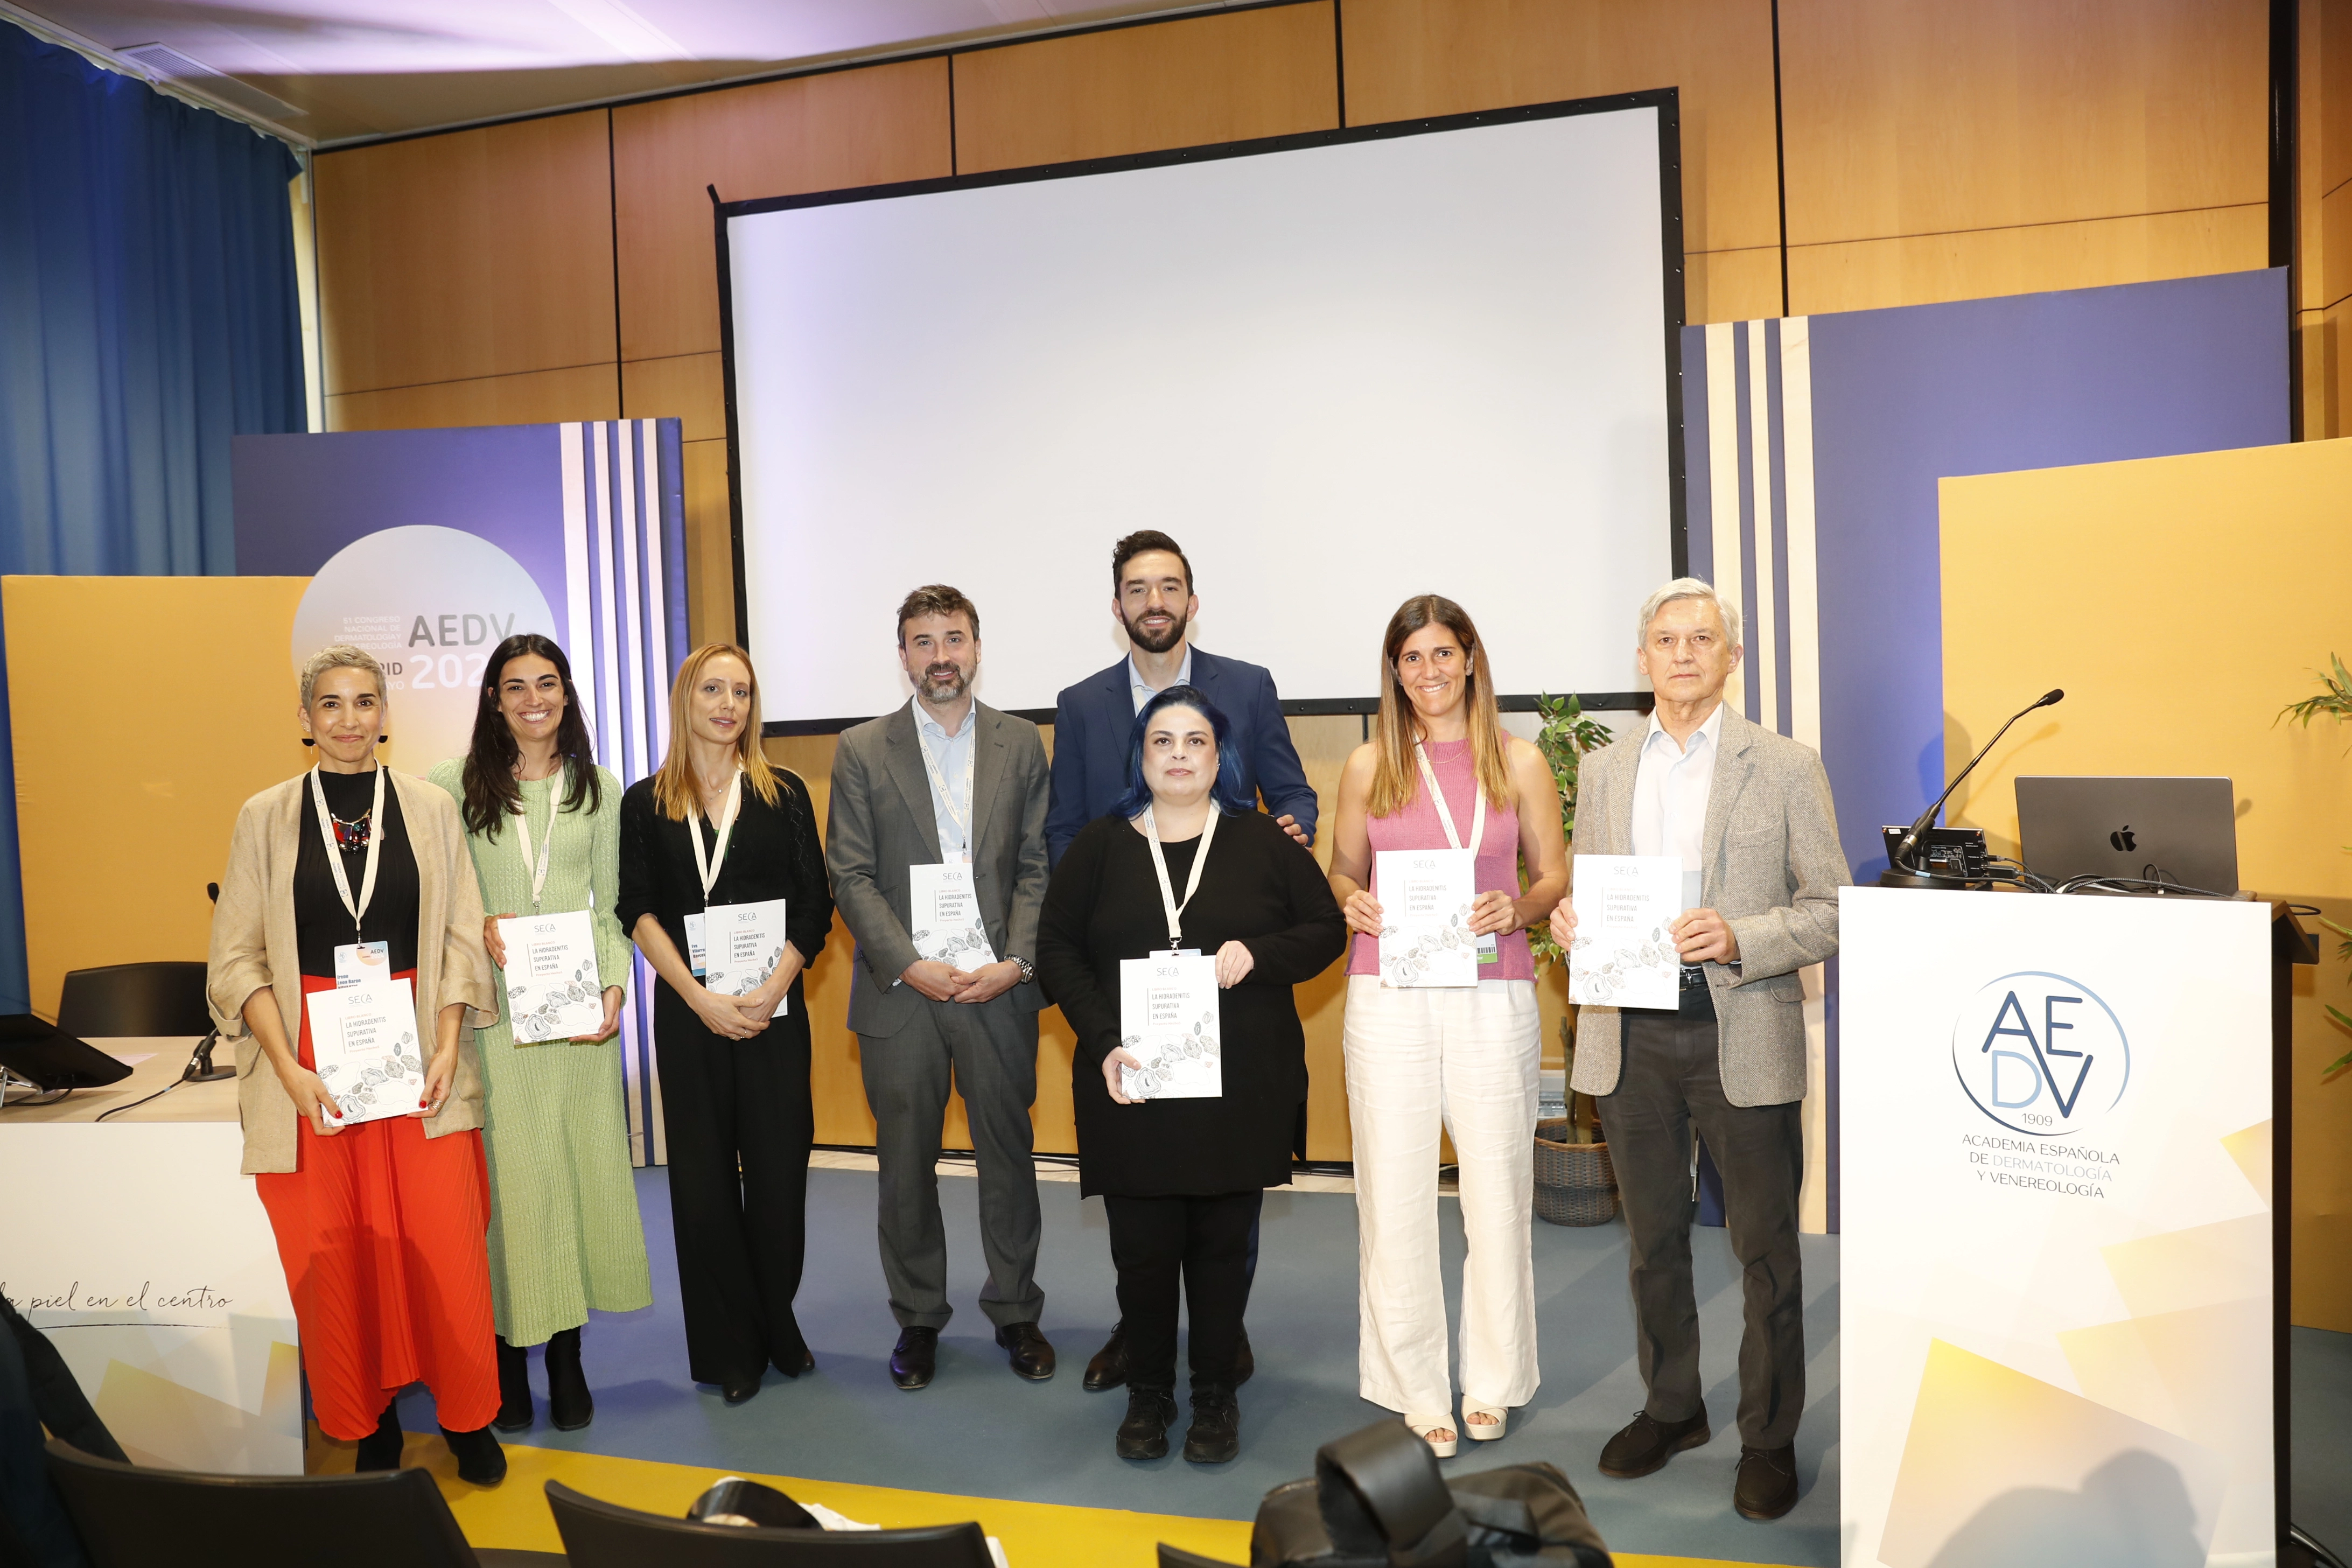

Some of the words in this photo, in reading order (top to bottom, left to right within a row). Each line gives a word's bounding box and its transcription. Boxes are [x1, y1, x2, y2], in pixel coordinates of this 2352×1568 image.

[408, 612, 515, 648] AEDV
[410, 652, 488, 689] 202
[739, 933, 765, 941] HIDRADENITIS
[538, 944, 569, 953] HIDRADENITIS
[347, 1027, 377, 1038] SUPURATIVA
[353, 1017, 387, 1027] HIDRADENITIS
[356, 1037, 375, 1046] ESPAÑA
[2021, 1113, 2053, 1126] 1909
[1962, 1134, 2035, 1153] ACADEMIA
[2040, 1144, 2120, 1165] ESPAÑOLA
[1970, 1152, 1989, 1165] DE
[1993, 1155, 2112, 1182] DERMATOLOGÍA
[1977, 1170, 1986, 1181] Y
[1990, 1171, 2105, 1199] VENEREOLOGÍA
[26, 1281, 79, 1322] piel
[87, 1296, 118, 1308] en
[127, 1281, 150, 1311] el
[157, 1285, 234, 1308] centro
